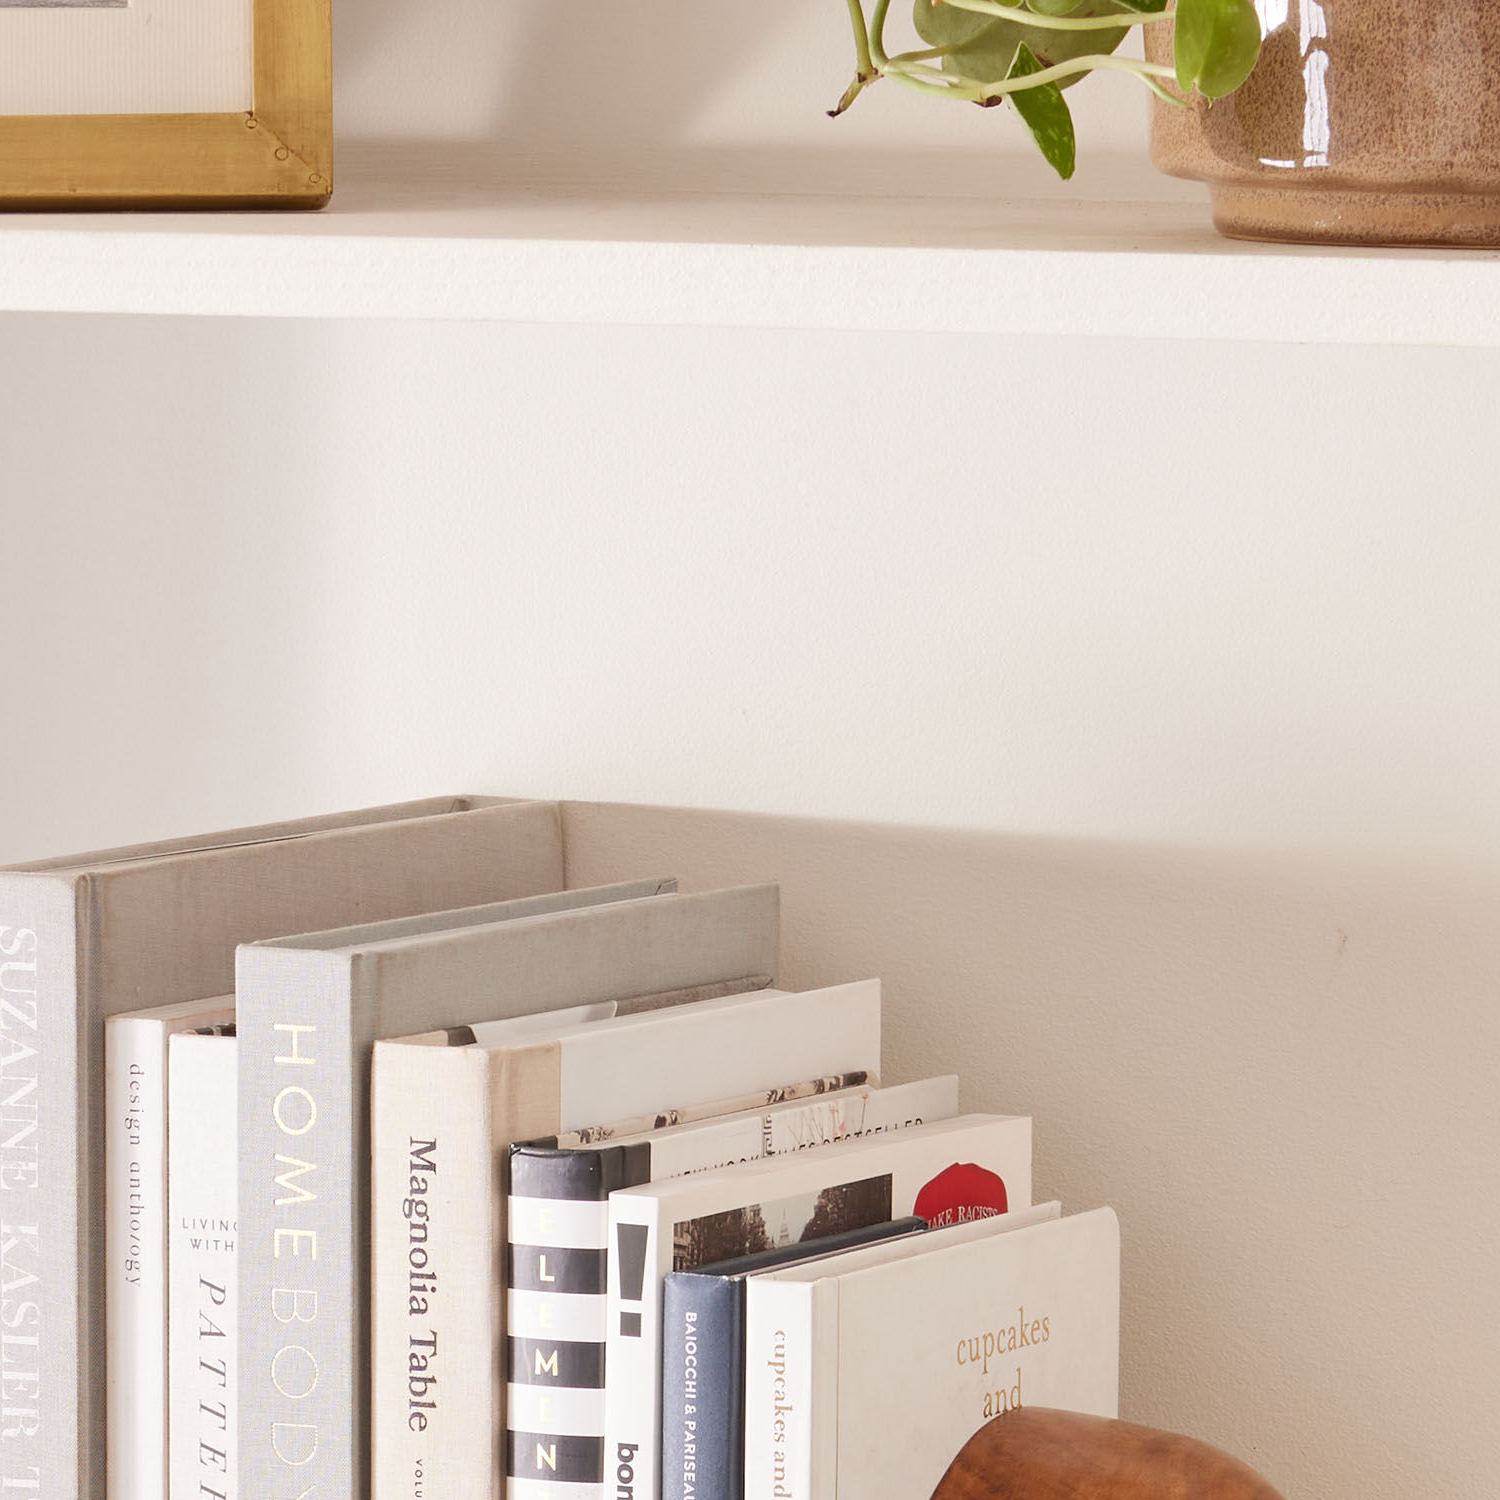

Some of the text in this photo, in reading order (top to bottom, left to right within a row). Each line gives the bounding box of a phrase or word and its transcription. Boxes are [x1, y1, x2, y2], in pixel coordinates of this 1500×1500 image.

[124, 1063, 145, 1287] design anthology
[189, 1238, 234, 1252] WITH
[402, 1136, 438, 1433] Magnolia Table
[685, 1311, 698, 1399] BAIOCCHI
[957, 1306, 1051, 1375] cupcakes
[684, 1402, 697, 1415] &
[767, 1330, 793, 1443] cupcakes
[983, 1367, 1022, 1418] and
[773, 1450, 793, 1498] and
